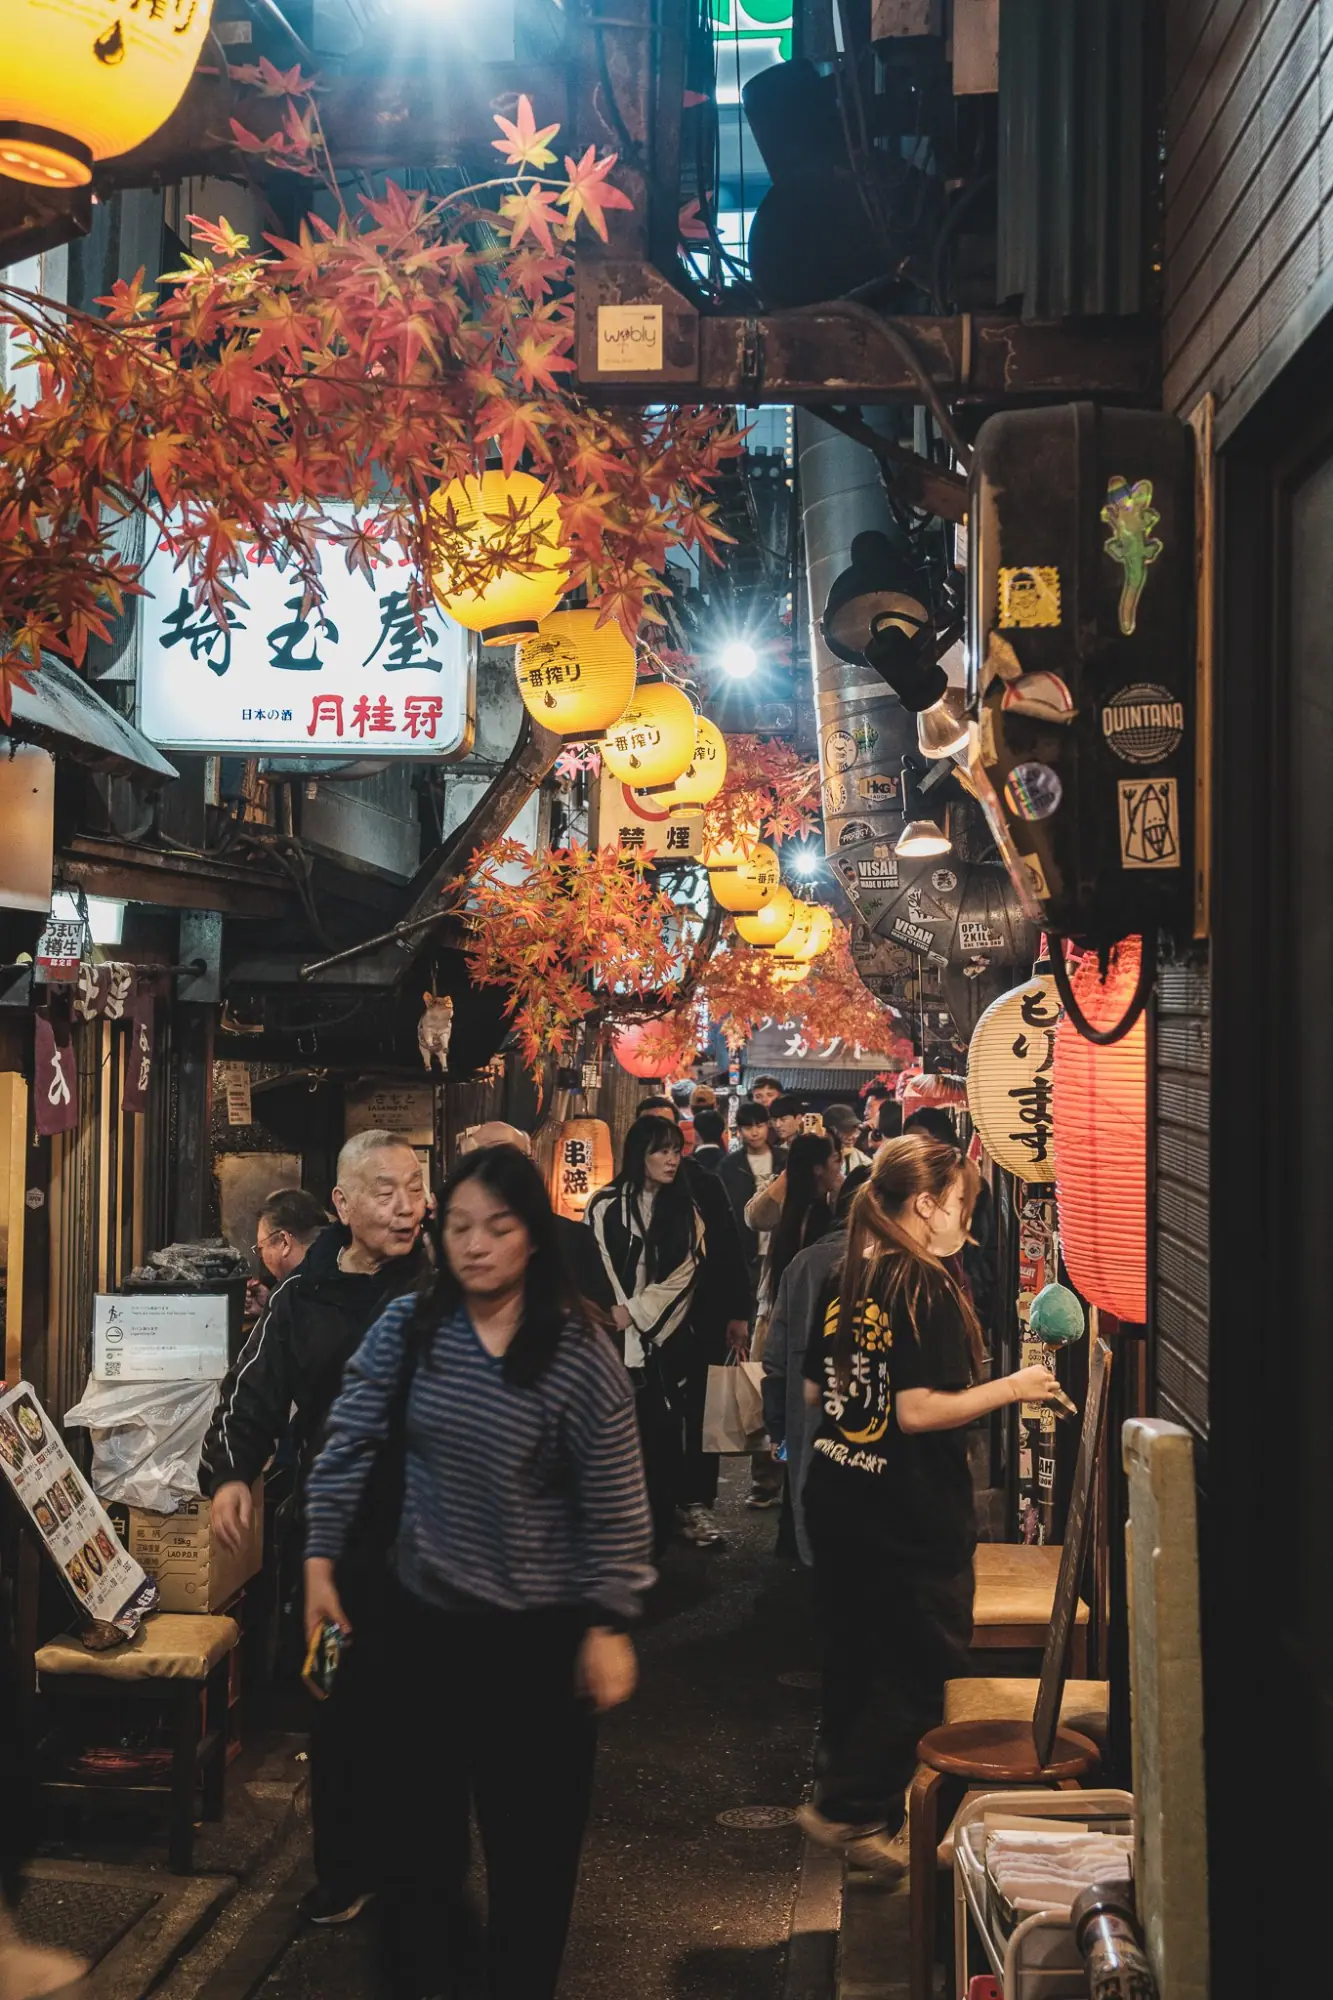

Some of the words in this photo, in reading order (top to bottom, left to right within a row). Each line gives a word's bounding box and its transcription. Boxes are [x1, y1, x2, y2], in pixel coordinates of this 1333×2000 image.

[520, 663, 581, 688] 一番搾り
[242, 708, 293, 722] 日本の酒
[306, 694, 443, 739] 月桂冠
[605, 730, 661, 752] 一番搾り
[619, 826, 690, 850] 禁煙
[858, 860, 898, 877] VISAH
[883, 879, 899, 888] LOOK
[894, 917, 935, 945] VISAH
[44, 938, 77, 956] 樽生
[563, 1140, 588, 1195] 串焼
[173, 1538, 191, 1547] 15kg
[167, 1550, 181, 1558] LAO
